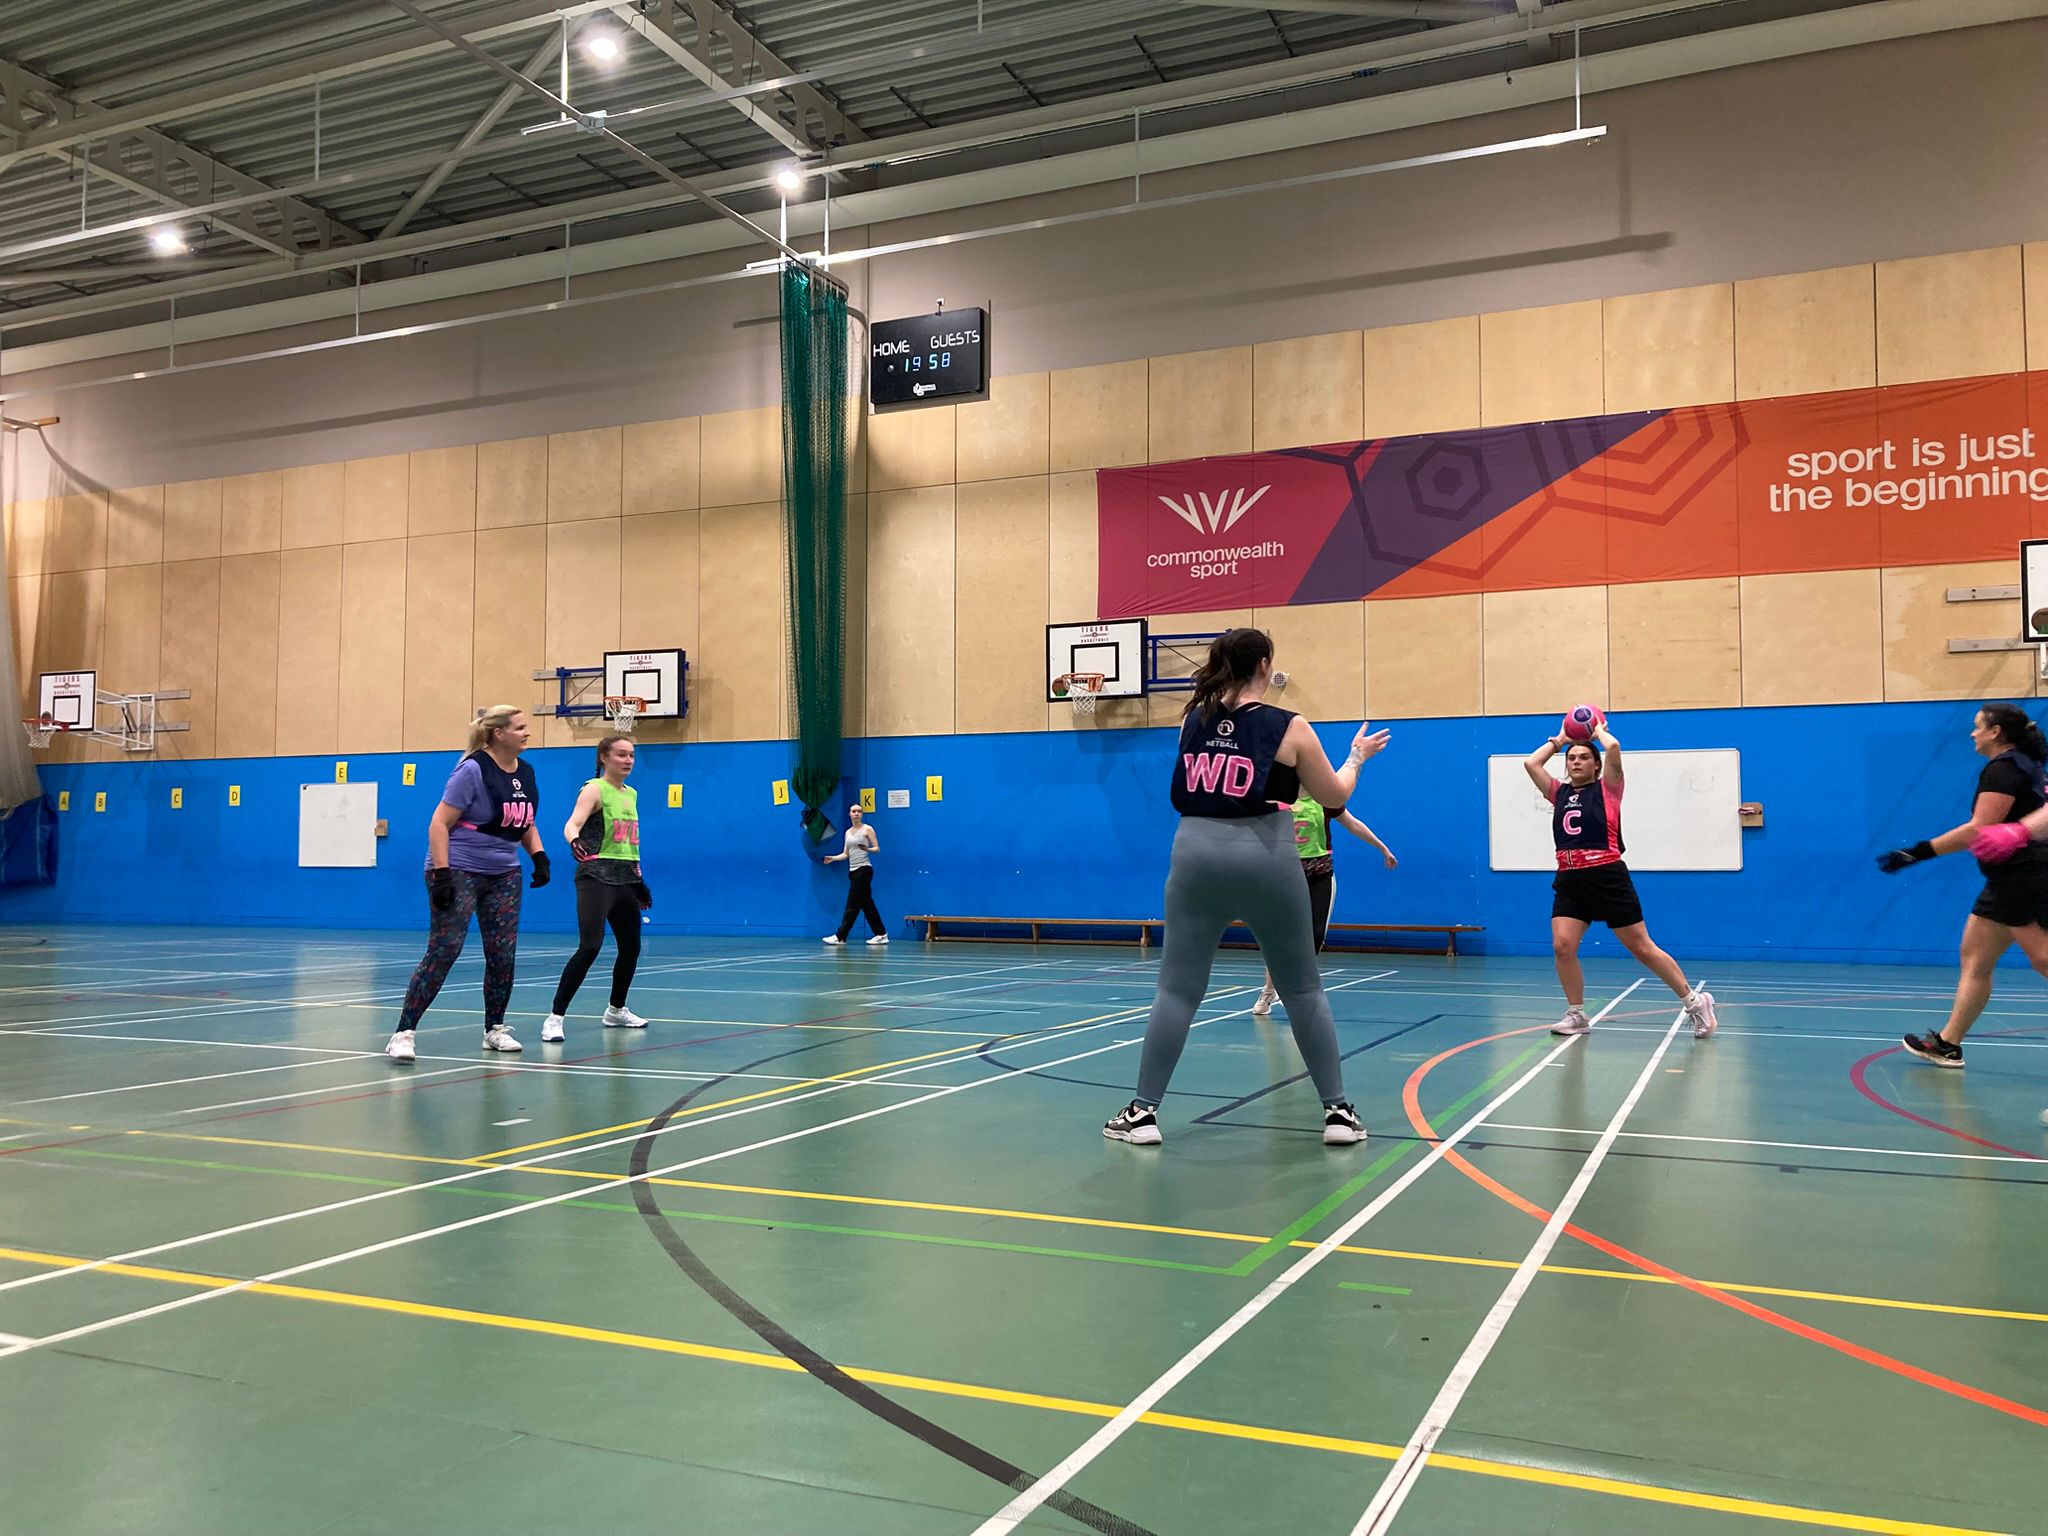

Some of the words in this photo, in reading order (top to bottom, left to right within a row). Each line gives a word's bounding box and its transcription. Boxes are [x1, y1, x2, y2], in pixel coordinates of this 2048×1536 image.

[873, 340, 910, 357] HOME
[930, 330, 980, 349] GUESTS
[1787, 440, 1896, 480] sport
[1912, 438, 1946, 467] is
[1957, 427, 2035, 470] just
[1769, 483, 1833, 512] the
[1846, 466, 2048, 511] beginning
[1147, 541, 1284, 567] commonwealth
[1190, 560, 1238, 579] sport
[1206, 740, 1239, 750] NETBALL
[338, 768, 344, 778] E
[406, 770, 412, 780] F
[1184, 753, 1255, 797] WD
[778, 787, 783, 799] J
[931, 783, 938, 795] L
[60, 796, 68, 806] A
[98, 798, 104, 807] B
[173, 793, 180, 803] C
[231, 792, 238, 801] D
[864, 795, 871, 807] K
[501, 801, 535, 828] WA
[1562, 810, 1582, 835] C
